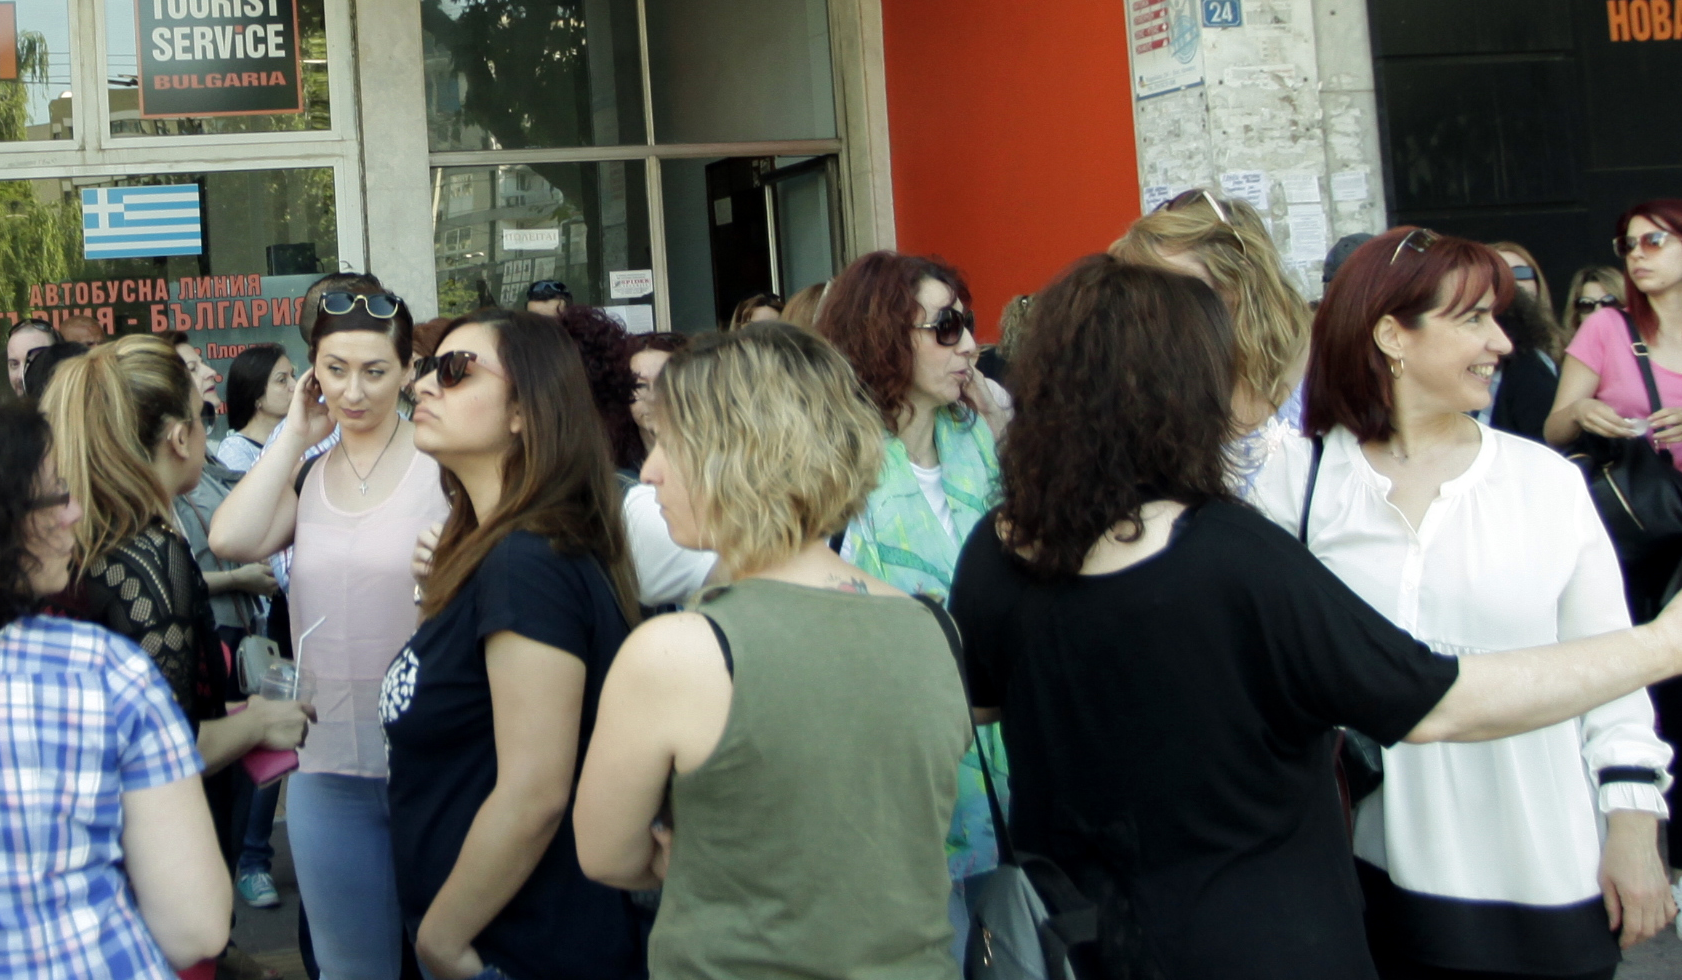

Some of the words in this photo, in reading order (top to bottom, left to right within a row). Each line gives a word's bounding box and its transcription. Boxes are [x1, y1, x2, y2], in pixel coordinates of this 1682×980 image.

[1208, 1, 1233, 23] 24
[153, 71, 287, 90] BULGARIA
[29, 278, 169, 307] АВТОБУСНА
[178, 273, 262, 300] ЛИНИЯ
